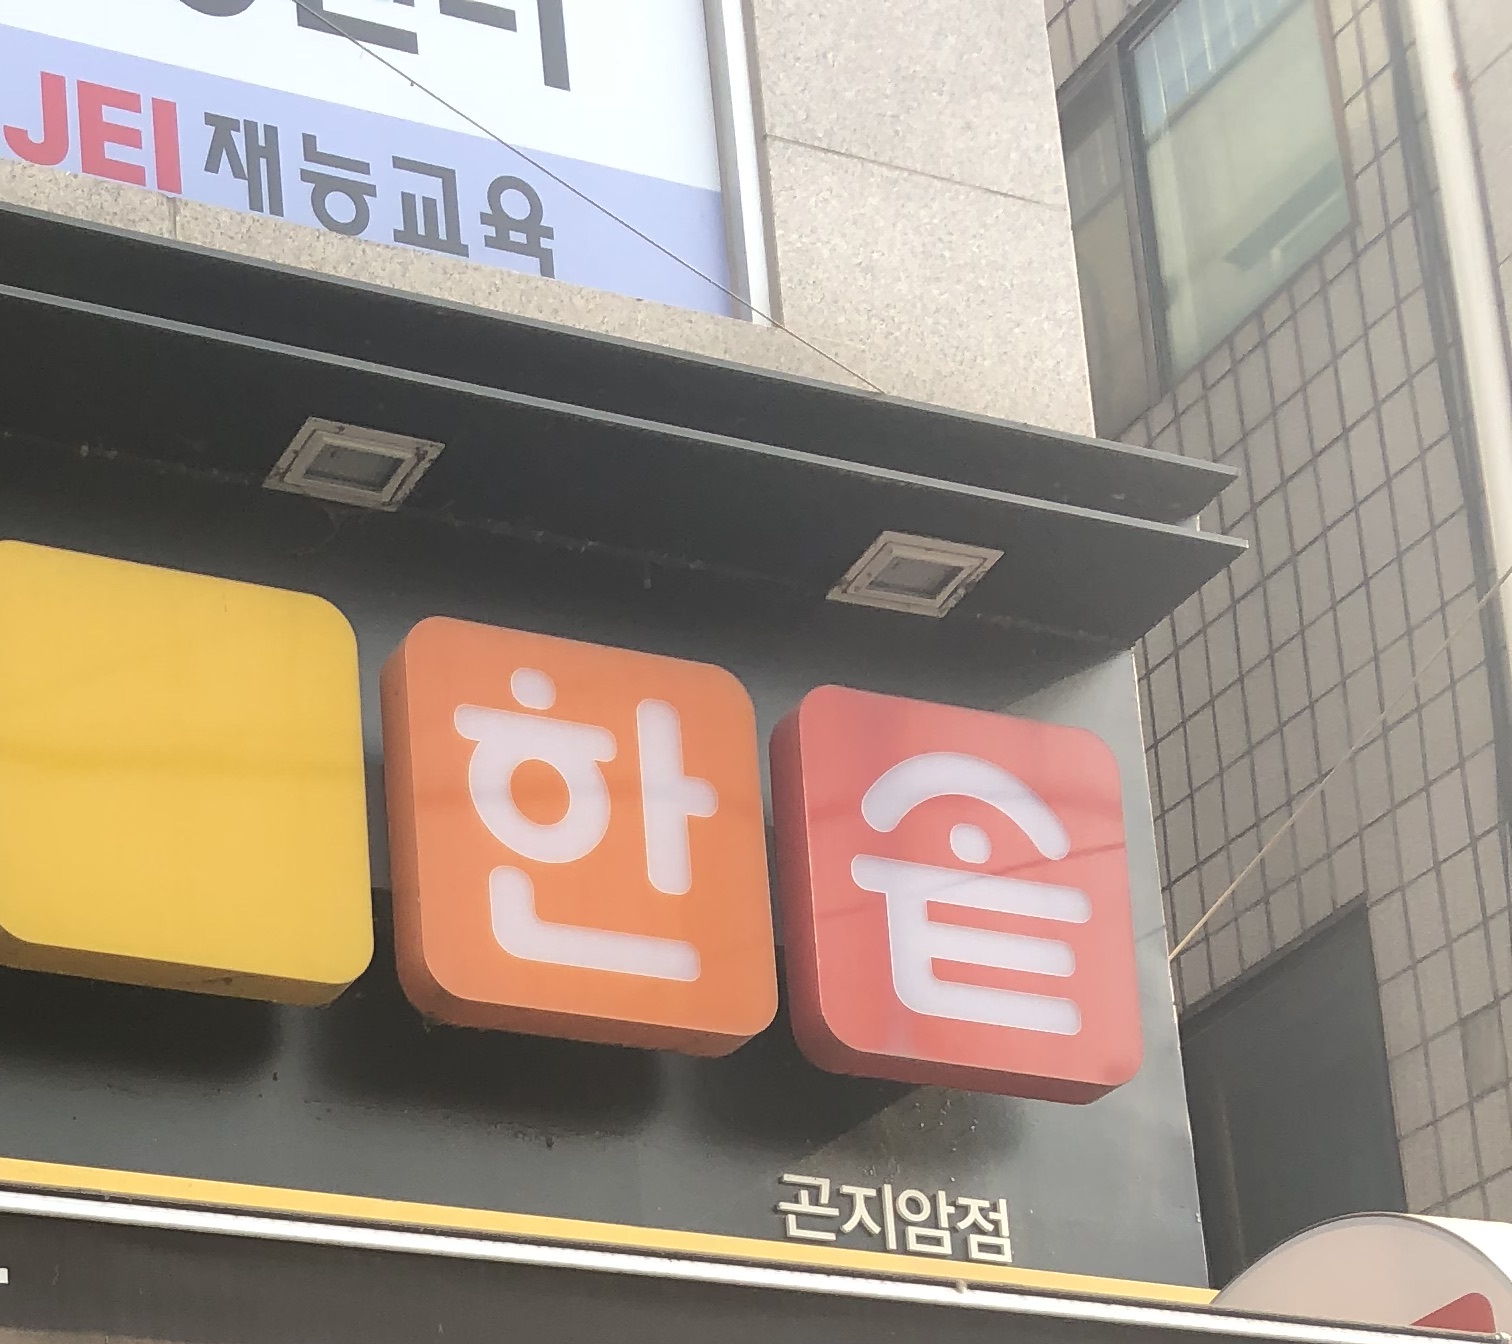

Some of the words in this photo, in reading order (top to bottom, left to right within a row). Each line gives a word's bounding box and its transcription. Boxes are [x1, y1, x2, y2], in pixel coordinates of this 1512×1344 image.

[2, 71, 183, 193] JEI
[203, 111, 555, 279] 재능교육
[777, 1173, 1013, 1264] 곤지암점
